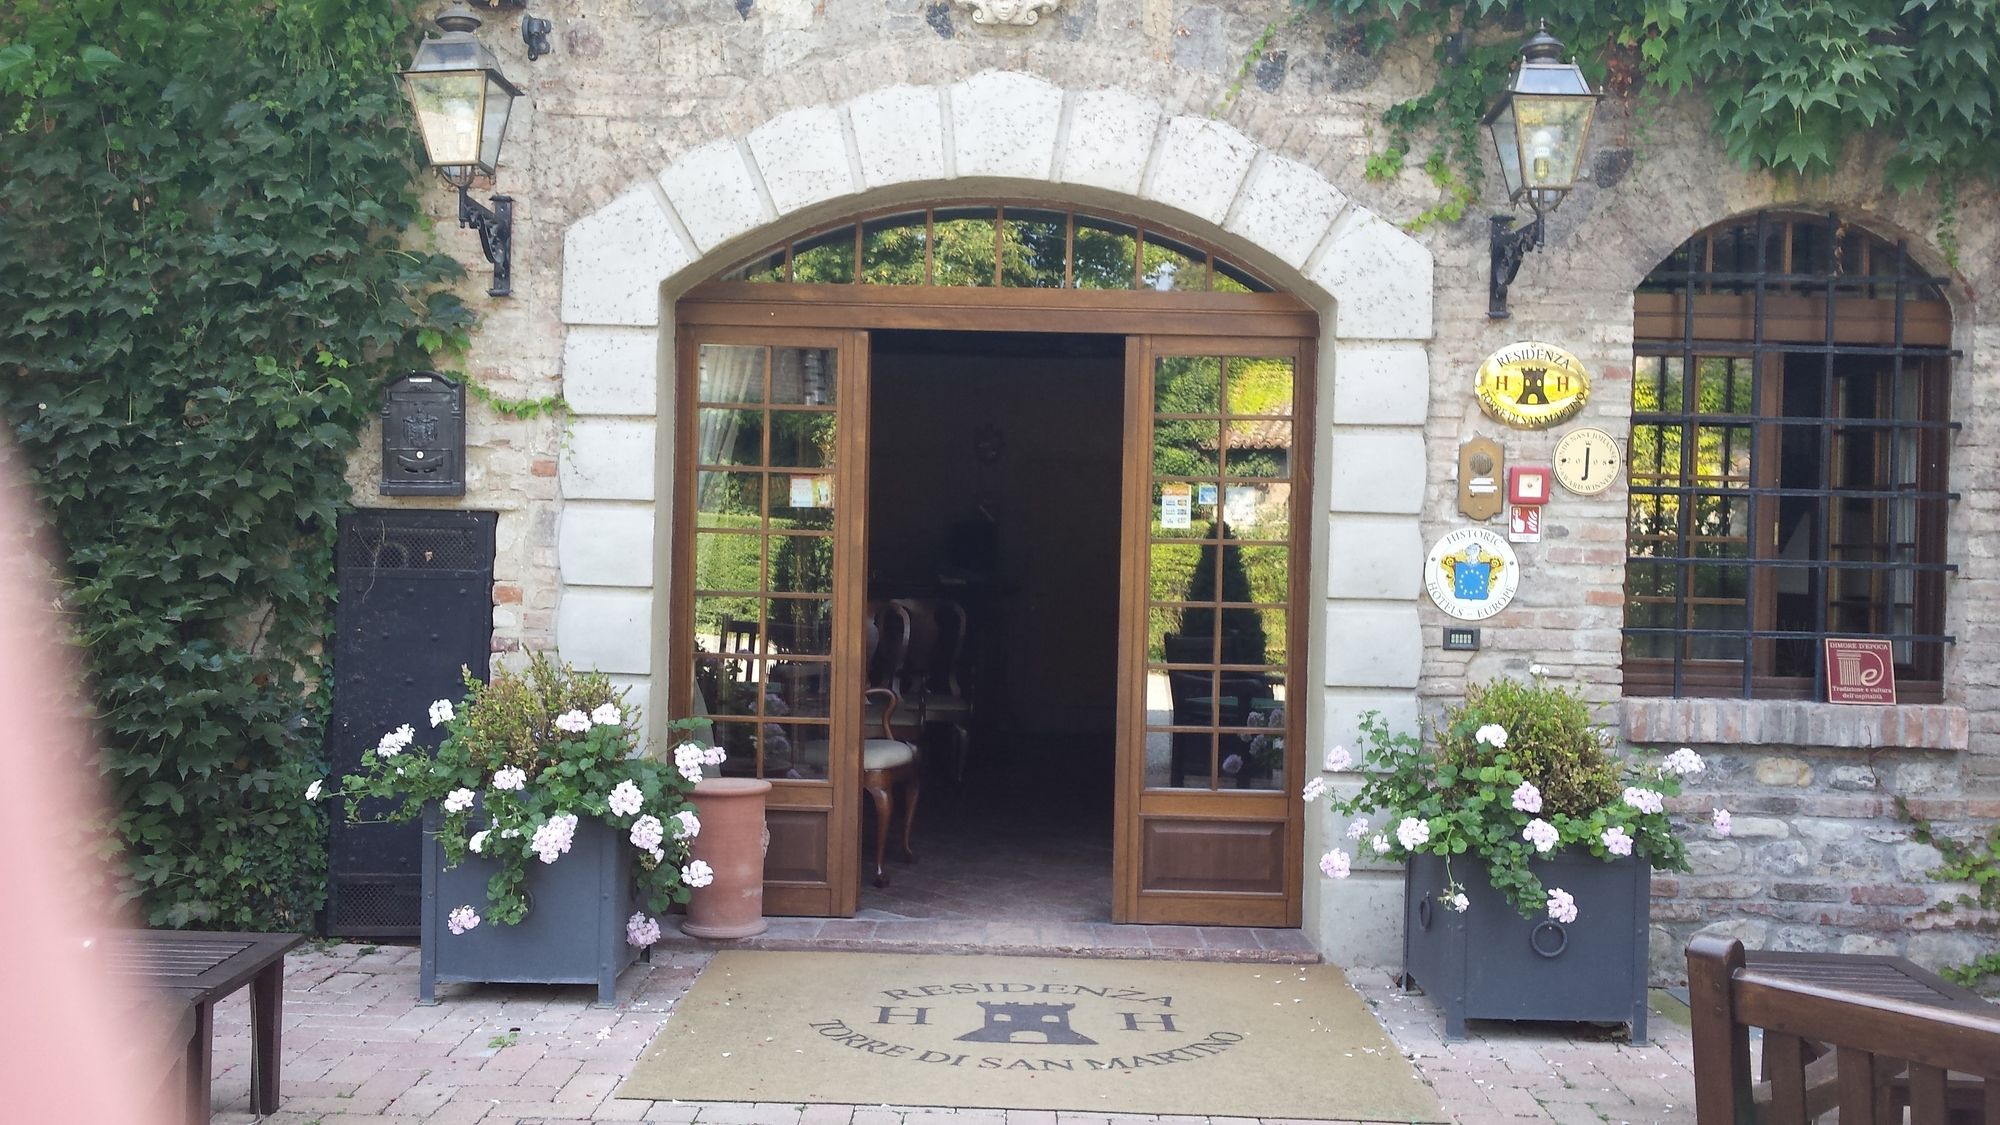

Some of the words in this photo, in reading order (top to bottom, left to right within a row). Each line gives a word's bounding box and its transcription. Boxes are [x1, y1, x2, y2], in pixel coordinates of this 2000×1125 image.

[1496, 349, 1570, 369] RESIDENZA
[1496, 376, 1508, 391] H
[1557, 376, 1569, 392] H
[1481, 389, 1506, 416] TORRE
[1507, 413, 1519, 423] DI
[1521, 416, 1542, 424] SAN
[1544, 391, 1585, 422] MARTINO
[1560, 471, 1584, 490] AWARD
[1585, 473, 1613, 491] WINNER
[1446, 528, 1504, 546] HISTORIC
[1427, 581, 1464, 617] HOTELS
[1477, 584, 1515, 618] EUROPE
[880, 983, 1173, 1008] RESIDENZA
[869, 1005, 936, 1025] H
[1114, 1012, 1185, 1032] H
[808, 1018, 915, 1058] TORRE
[912, 1050, 970, 1066] DI
[978, 1056, 1075, 1072] SAN
[1083, 1031, 1244, 1069] MARTINO
